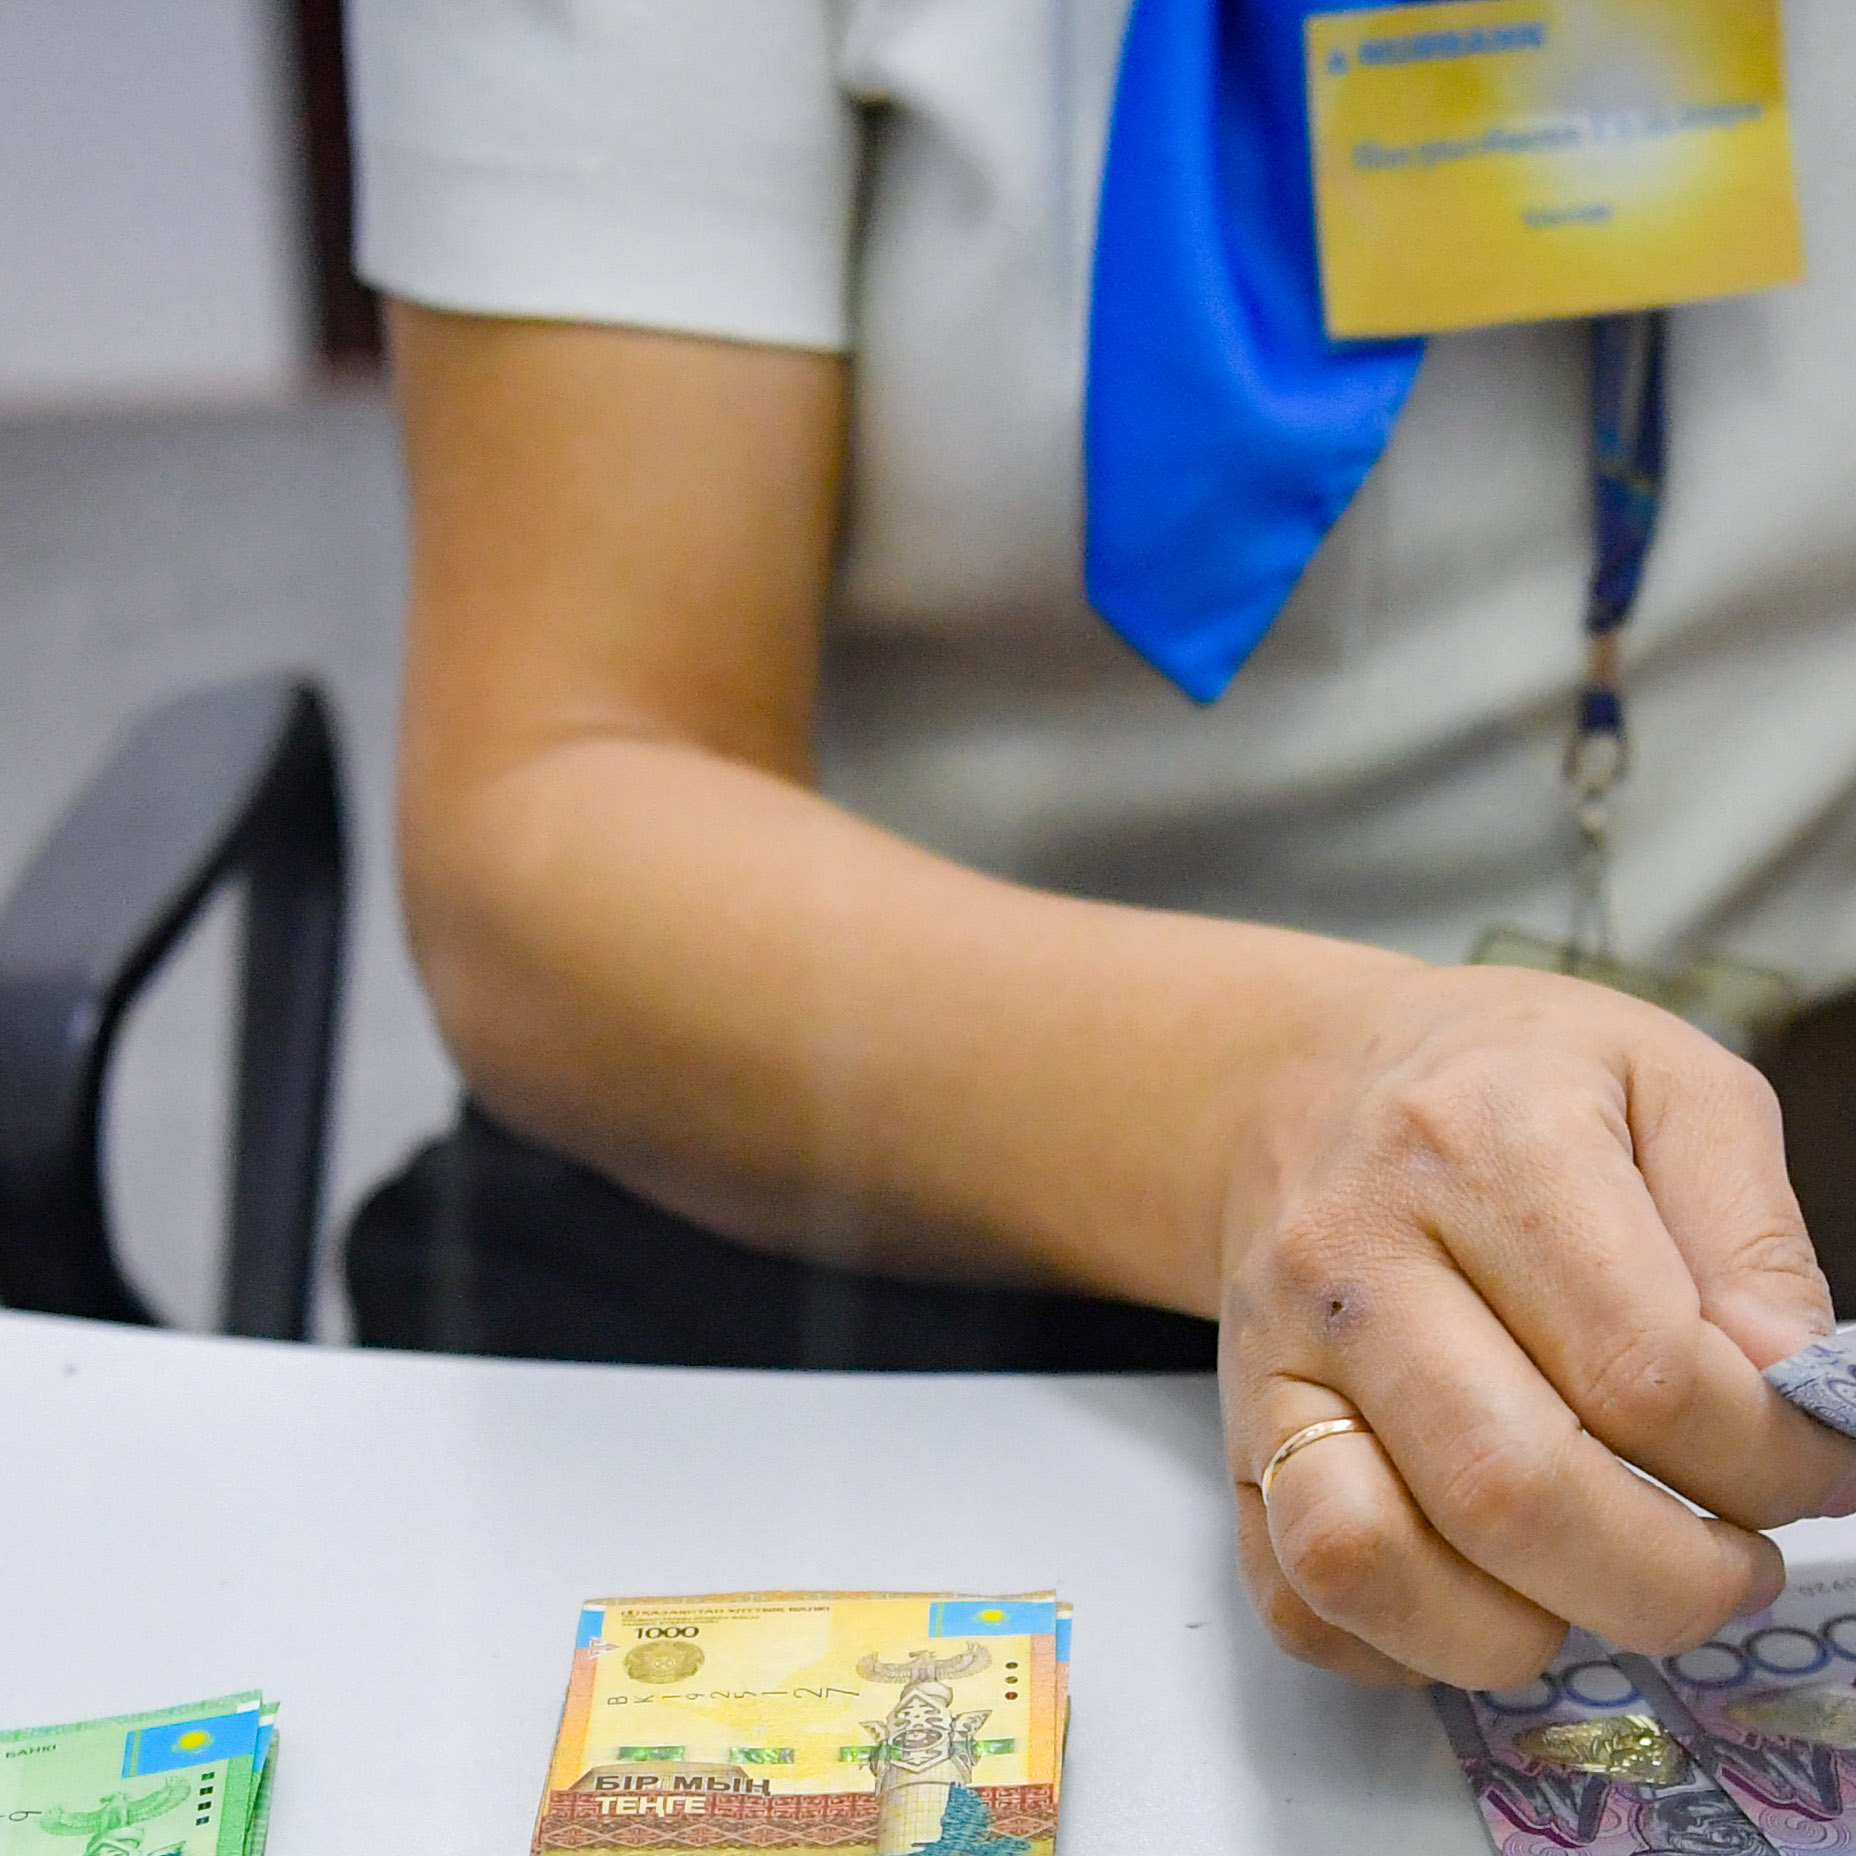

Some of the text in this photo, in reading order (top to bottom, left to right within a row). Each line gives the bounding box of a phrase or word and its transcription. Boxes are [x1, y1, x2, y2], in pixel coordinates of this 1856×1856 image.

[635, 1625, 700, 1639] 1000
[595, 1774, 772, 1798] БІР МЫҢ
[595, 1795, 708, 1818] ТЕҢГЕ
